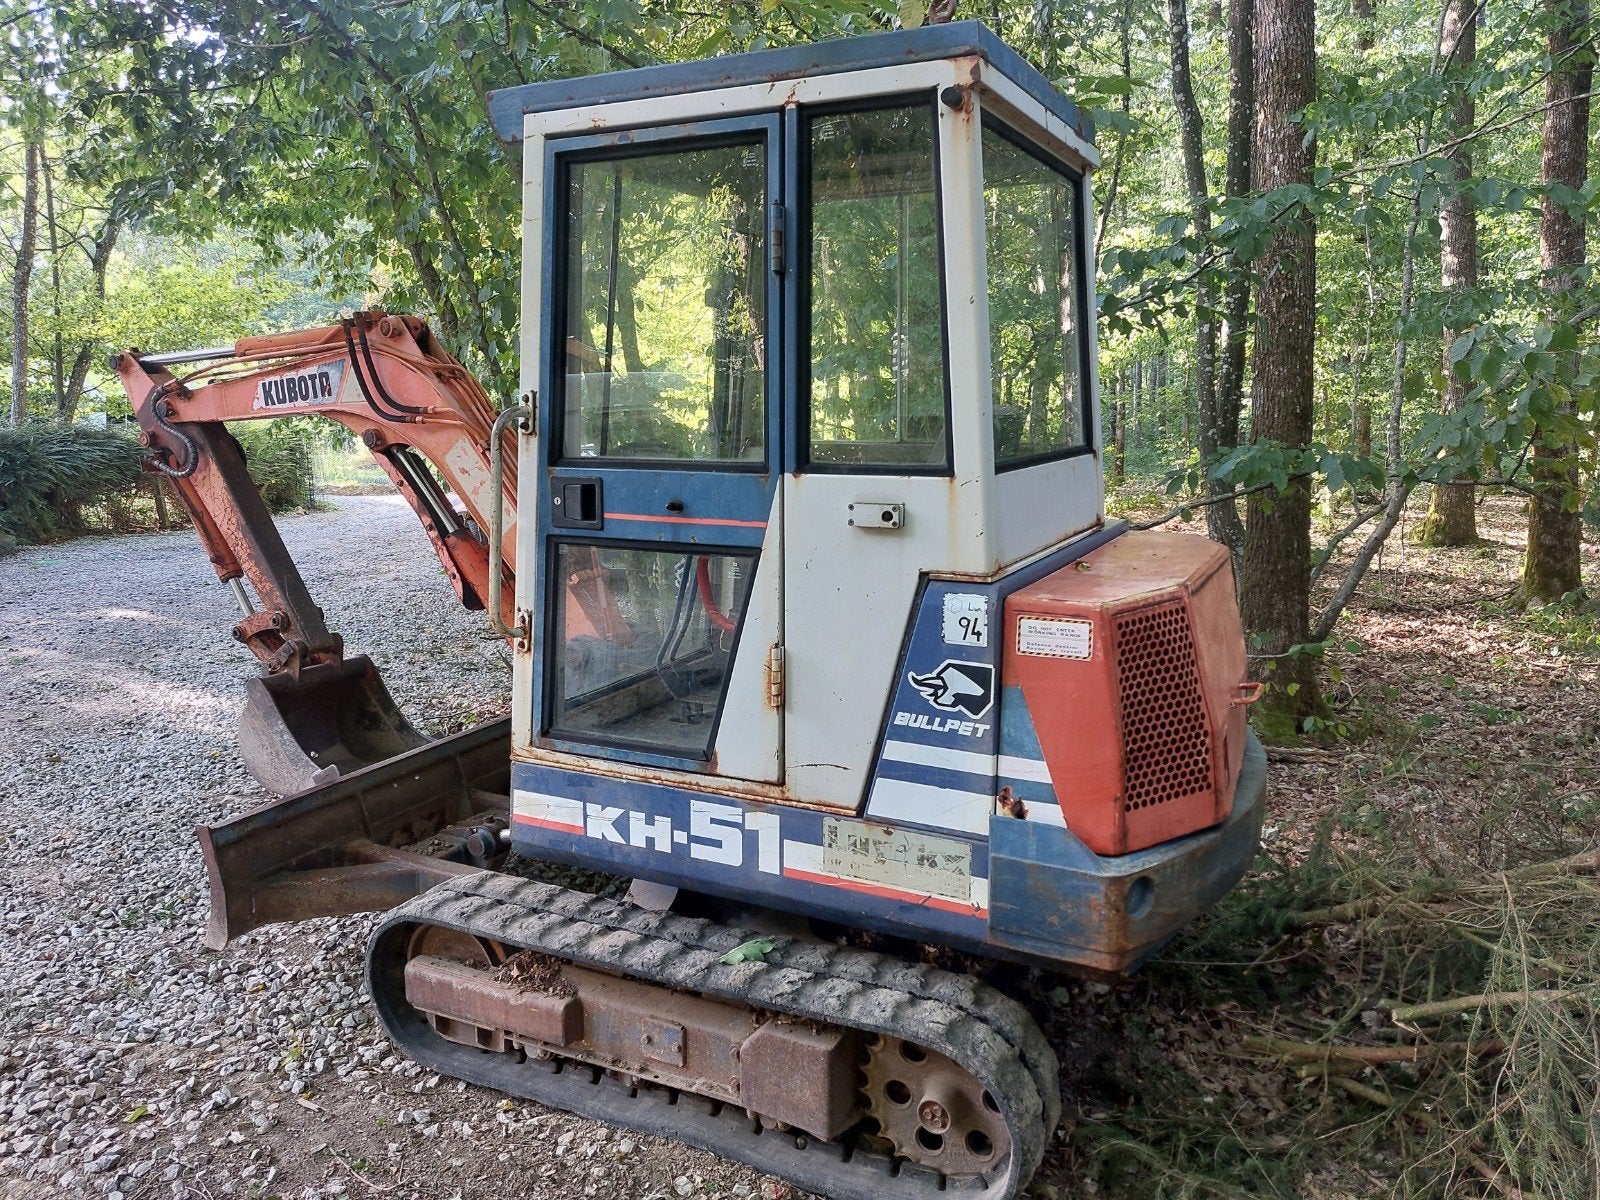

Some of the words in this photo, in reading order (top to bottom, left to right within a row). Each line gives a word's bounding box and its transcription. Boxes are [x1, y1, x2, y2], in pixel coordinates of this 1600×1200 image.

[262, 371, 332, 406] KUBOTA
[958, 616, 983, 642] 94
[893, 711, 991, 738] BULLPET
[586, 799, 780, 875] KH-51
